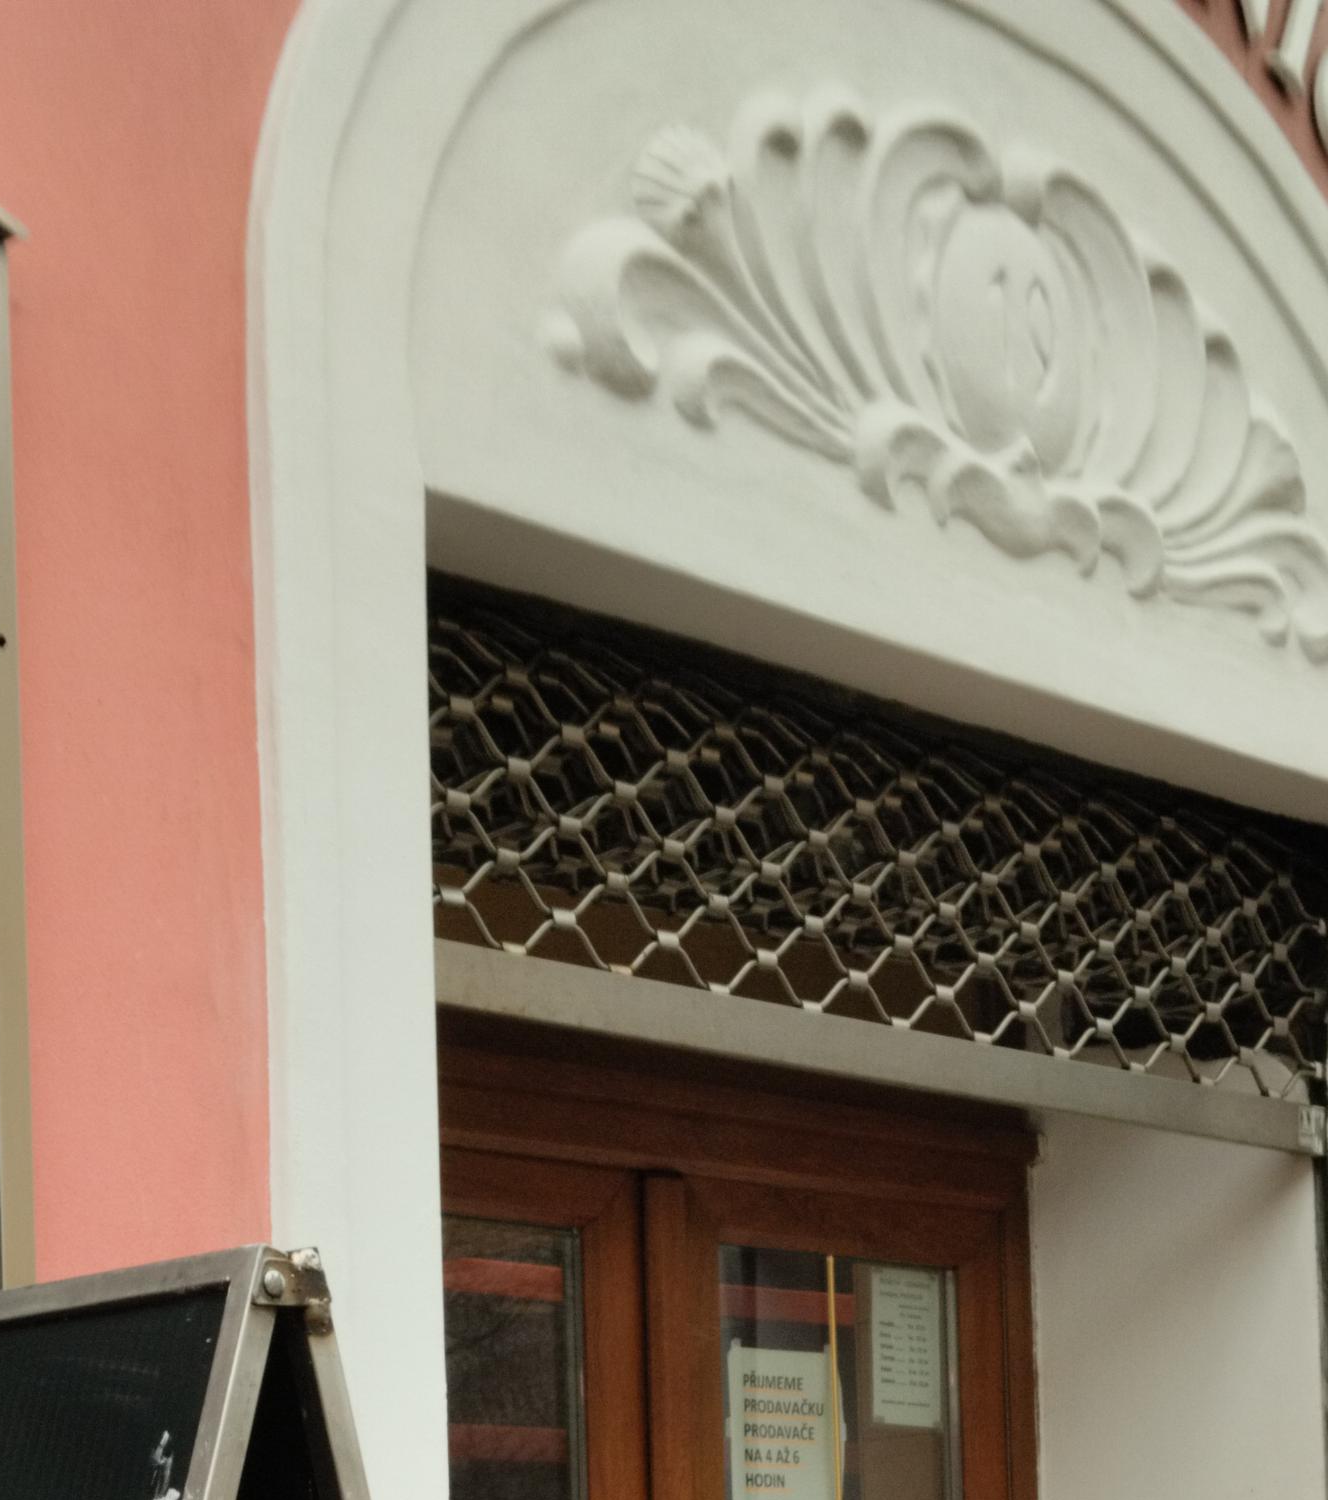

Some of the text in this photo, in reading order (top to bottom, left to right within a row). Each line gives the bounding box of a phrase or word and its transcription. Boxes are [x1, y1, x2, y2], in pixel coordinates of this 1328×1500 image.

[743, 1370, 803, 1391] PŘIJMEME
[743, 1398, 824, 1417] PRODAVAČKU
[743, 1423, 815, 1441] PRODAVAČE
[744, 1446, 800, 1464] NA 4 AŽ 6
[745, 1472, 785, 1488] HODIN
